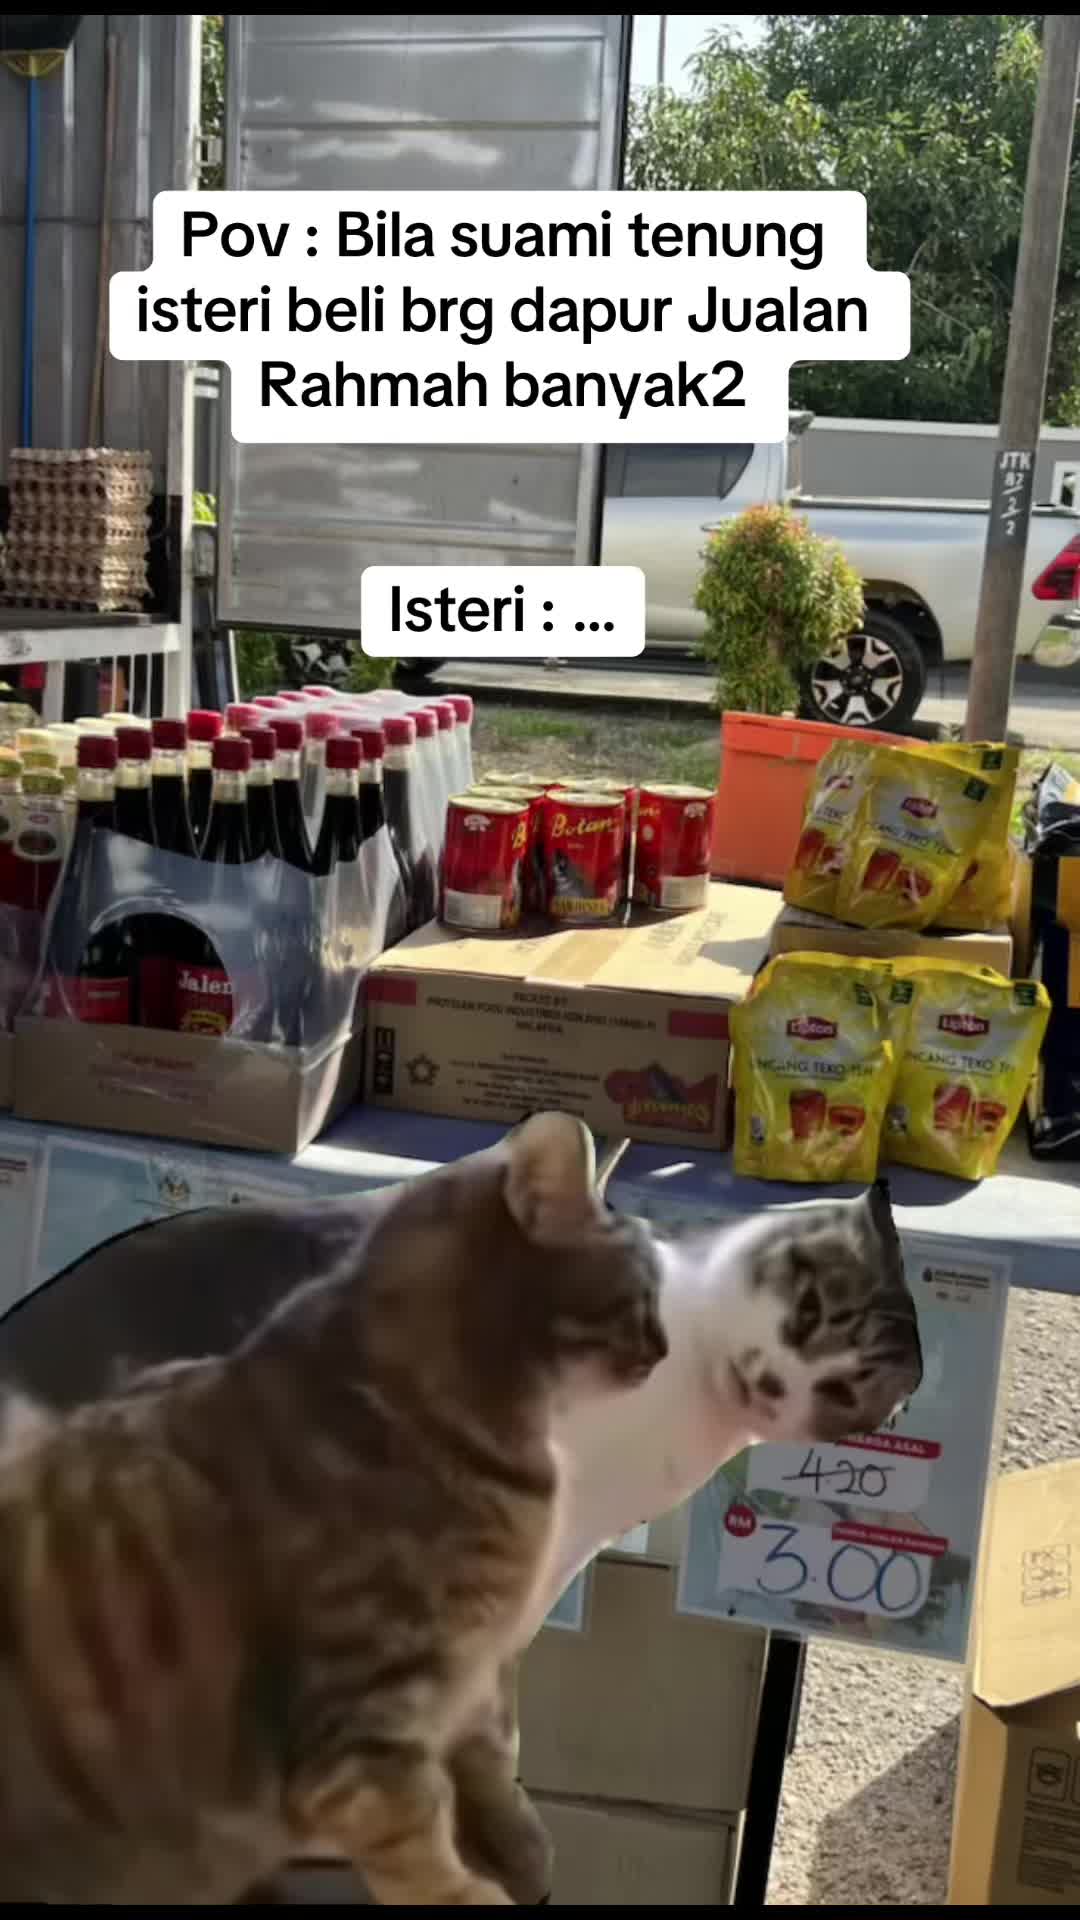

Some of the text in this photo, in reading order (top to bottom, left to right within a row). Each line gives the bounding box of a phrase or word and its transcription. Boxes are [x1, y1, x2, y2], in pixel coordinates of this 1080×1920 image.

[999, 452, 1031, 470] JTK
[797, 1447, 888, 1498] 4.20
[728, 1513, 752, 1529] RM
[756, 1523, 923, 1613] 3.00
